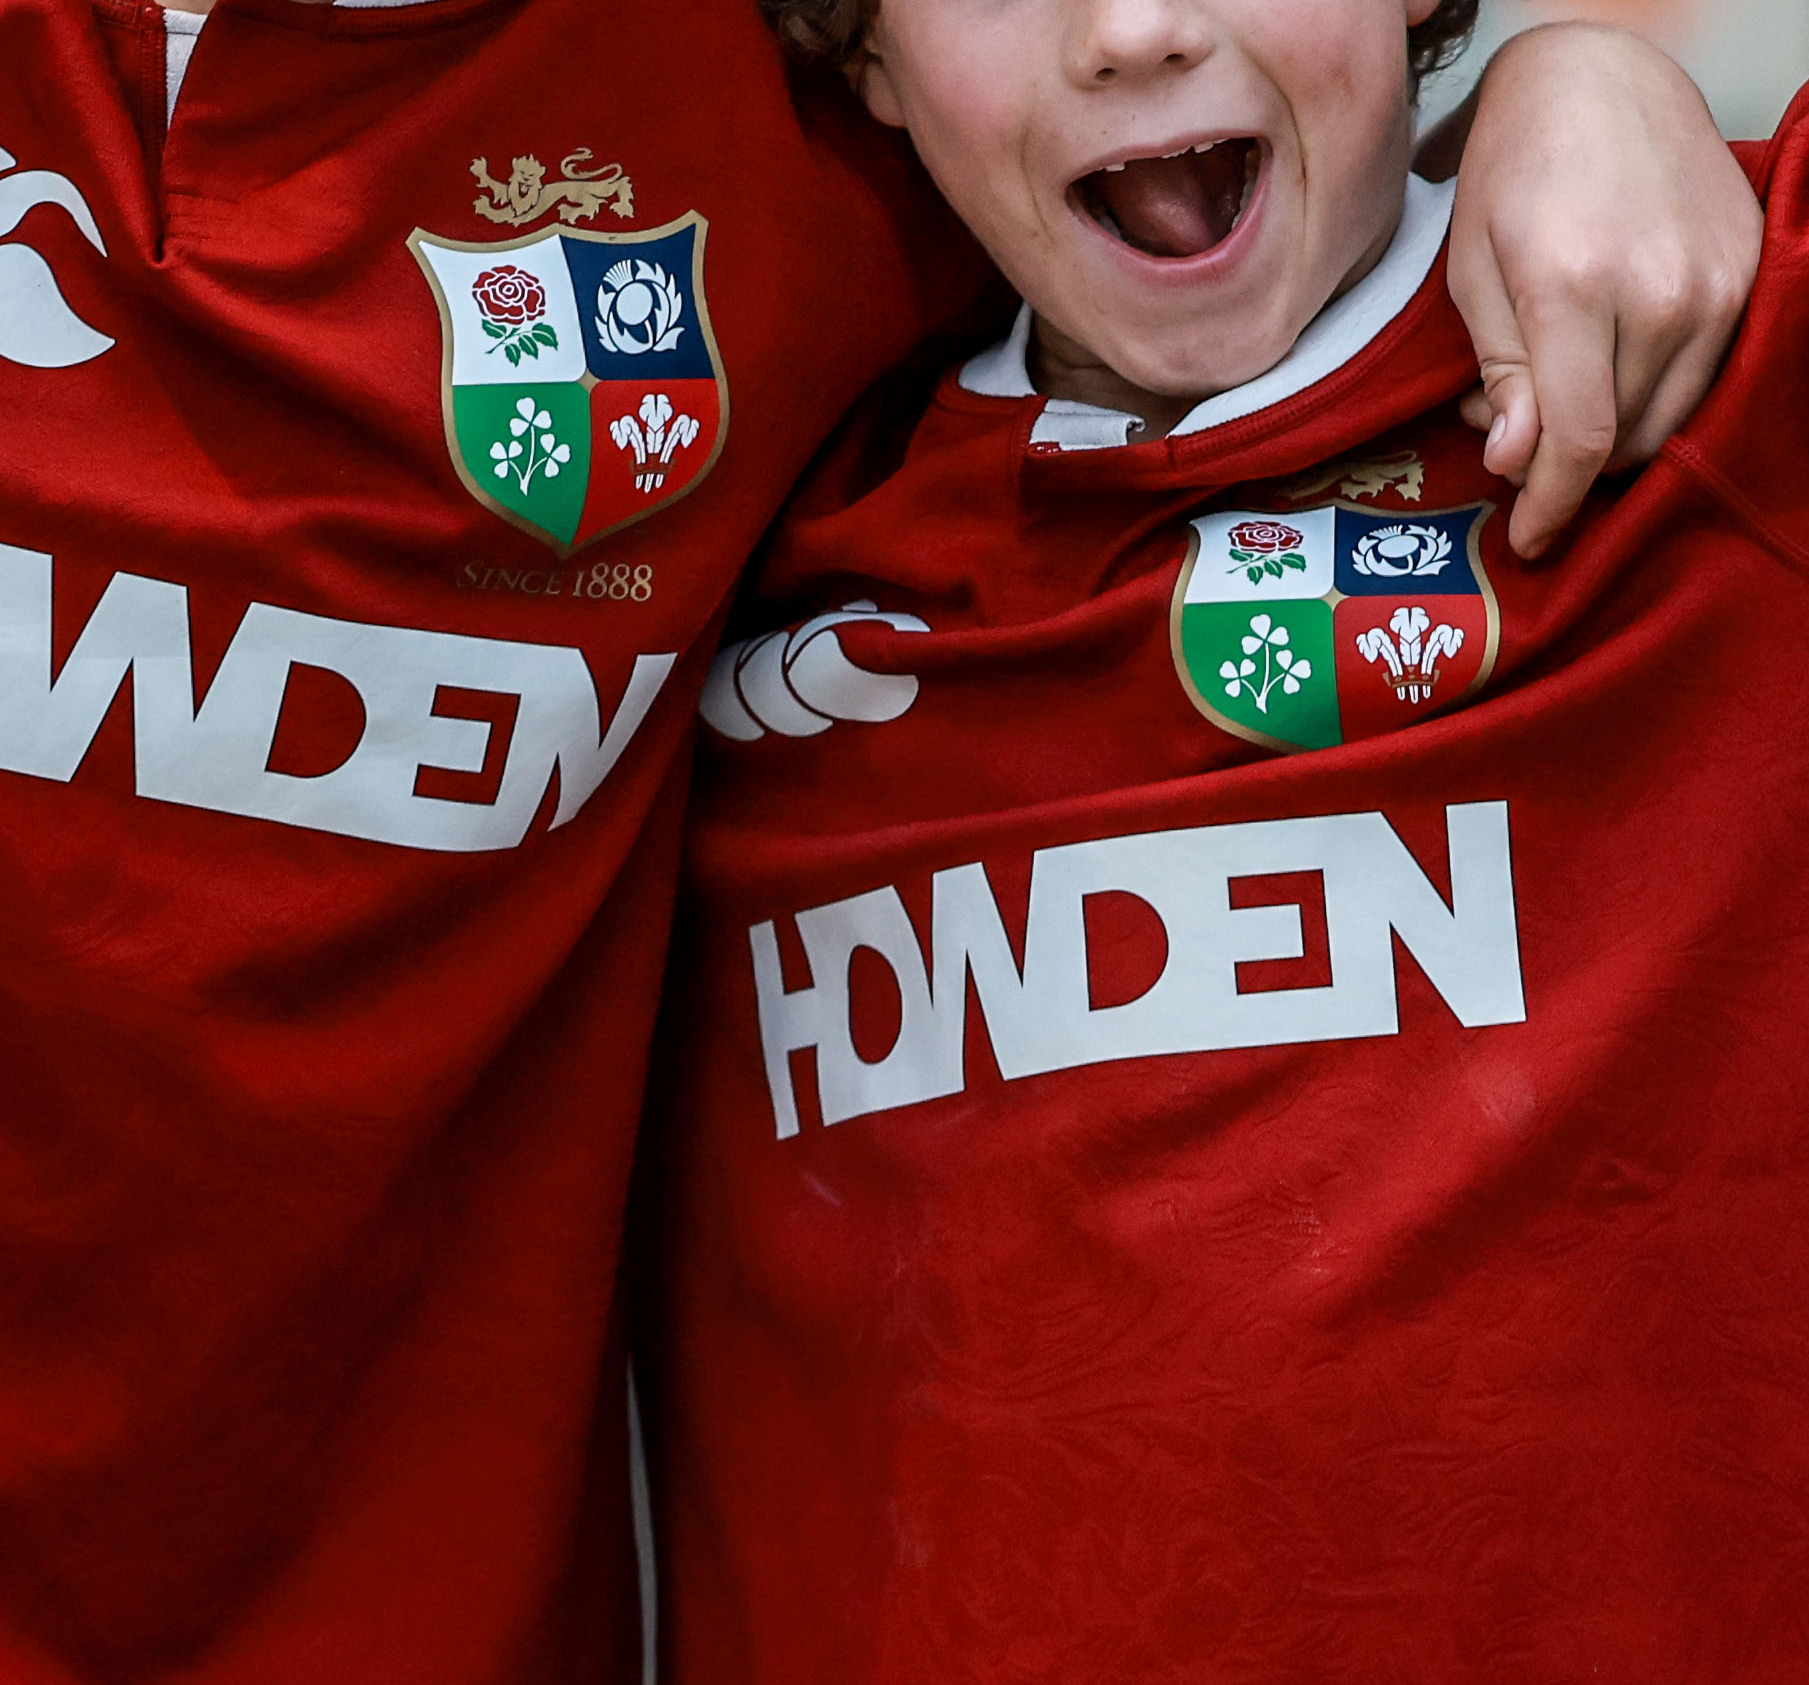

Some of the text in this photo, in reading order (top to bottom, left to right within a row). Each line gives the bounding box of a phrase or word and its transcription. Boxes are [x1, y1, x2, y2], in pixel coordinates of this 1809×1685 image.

[457, 559, 653, 602] SINCE 1888
[748, 800, 1526, 1140] HOWDEN
